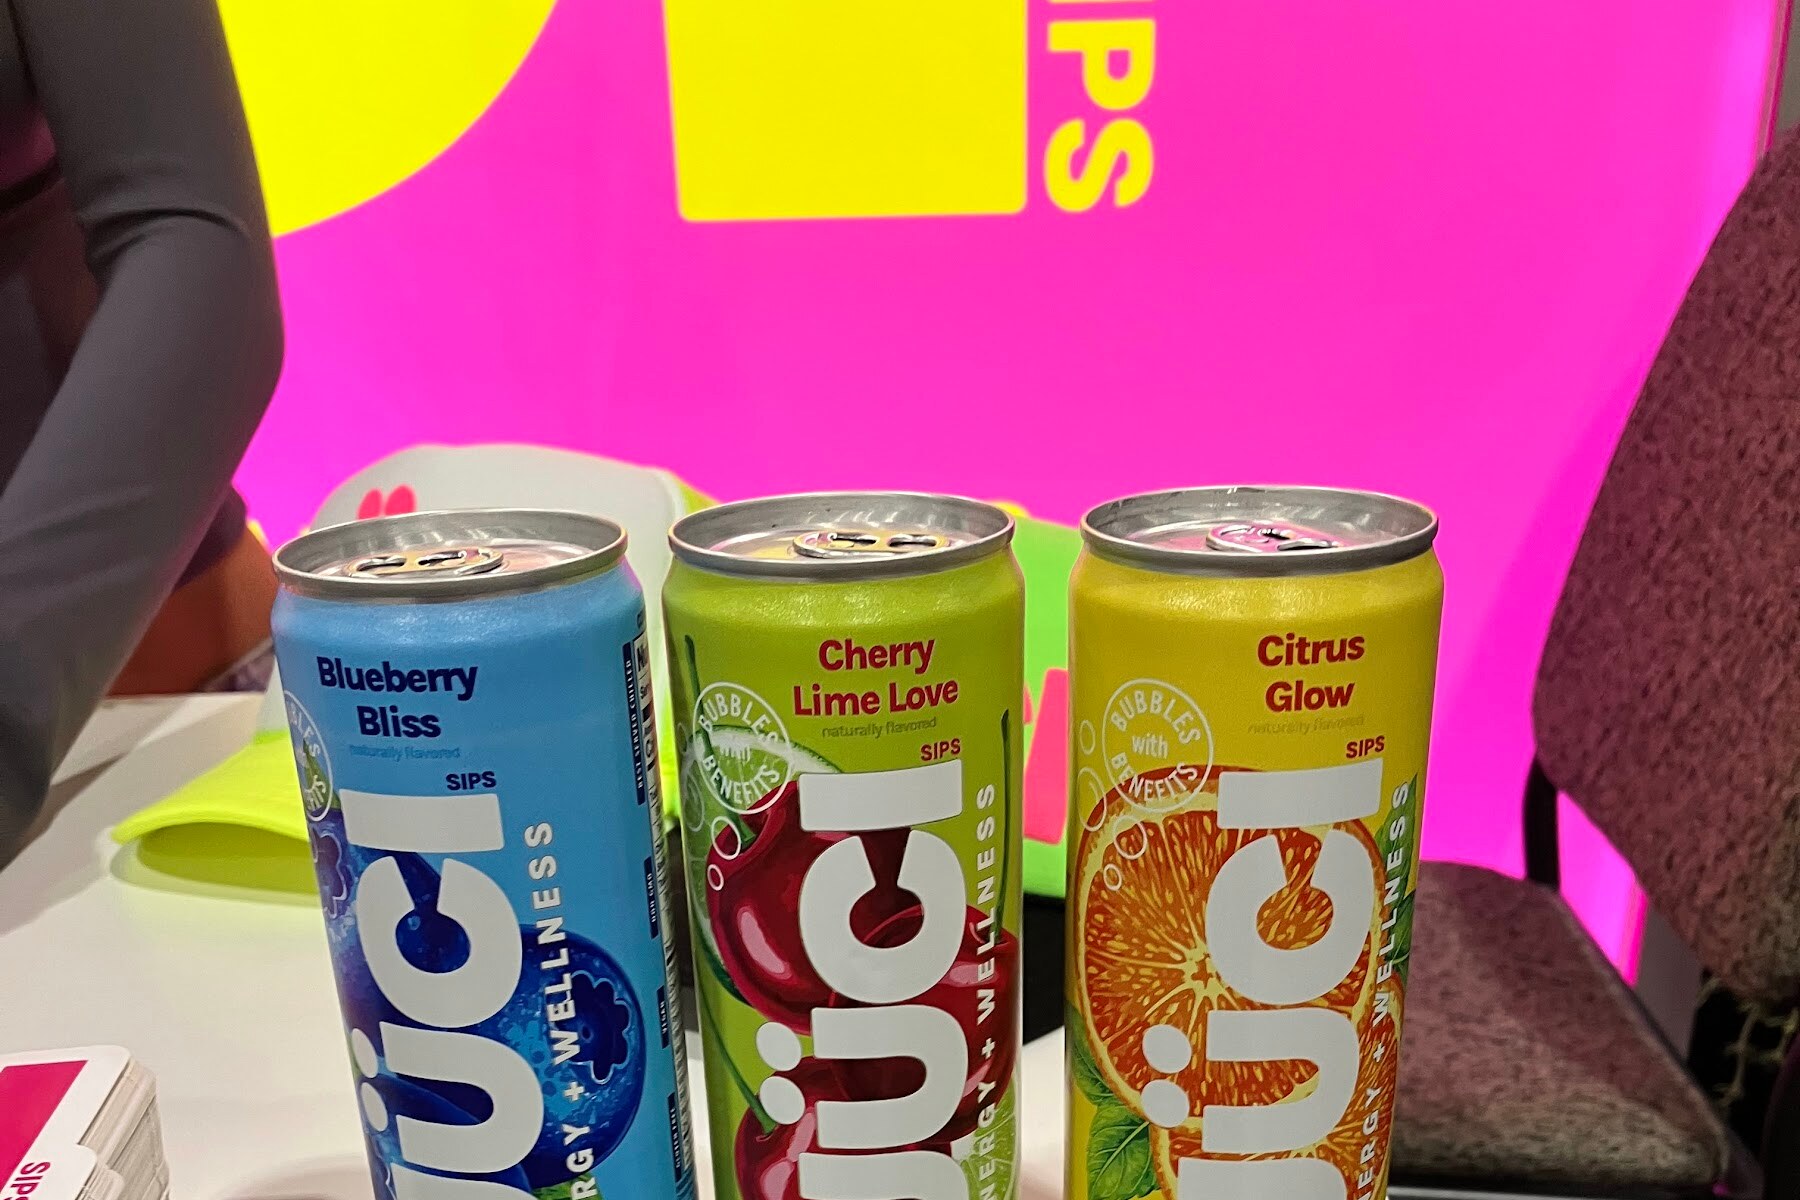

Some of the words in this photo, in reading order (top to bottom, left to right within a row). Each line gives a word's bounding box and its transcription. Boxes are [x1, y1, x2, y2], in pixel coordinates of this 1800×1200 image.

[1044, 0, 1156, 213] PS
[819, 638, 936, 675] Cherry
[1257, 632, 1365, 668] Citrus
[316, 656, 478, 701] Blueberry
[1265, 680, 1355, 713] Glow
[793, 683, 880, 717] Lime
[889, 679, 959, 713] Love
[357, 705, 441, 739] Bliss
[822, 722, 884, 740] naturally
[886, 716, 938, 733] flavored
[1110, 690, 1201, 745] BUBBLES
[920, 738, 961, 762] SIPS
[1132, 733, 1168, 759] with
[1346, 735, 1385, 758] SIPS
[446, 771, 497, 791] SIPS
[703, 755, 780, 805] BENEFITS
[1111, 752, 1199, 803] BENEFITS
[976, 783, 997, 1025] WELLNESS
[1371, 781, 1409, 1026] WELLNESS
[524, 821, 585, 1067] WELLNESS
